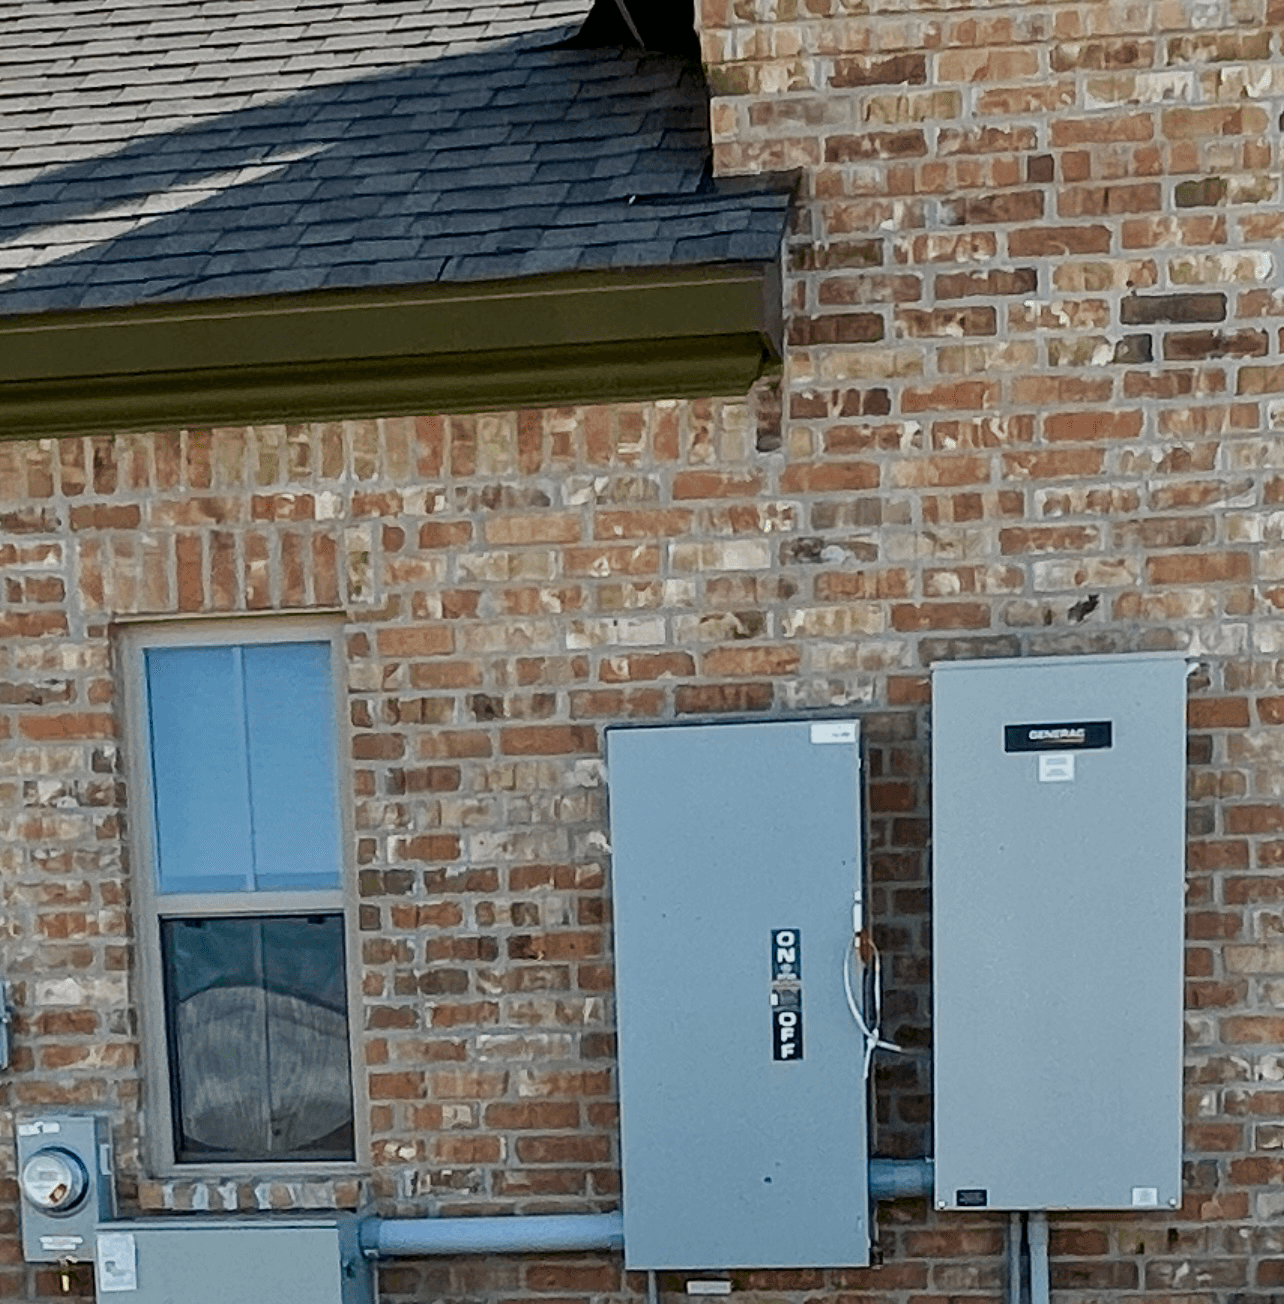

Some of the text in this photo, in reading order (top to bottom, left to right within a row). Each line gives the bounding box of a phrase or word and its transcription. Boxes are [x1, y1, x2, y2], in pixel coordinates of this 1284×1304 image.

[1028, 728, 1085, 740] GENERAC
[776, 931, 795, 963] ON
[778, 1012, 797, 1059] OFF
